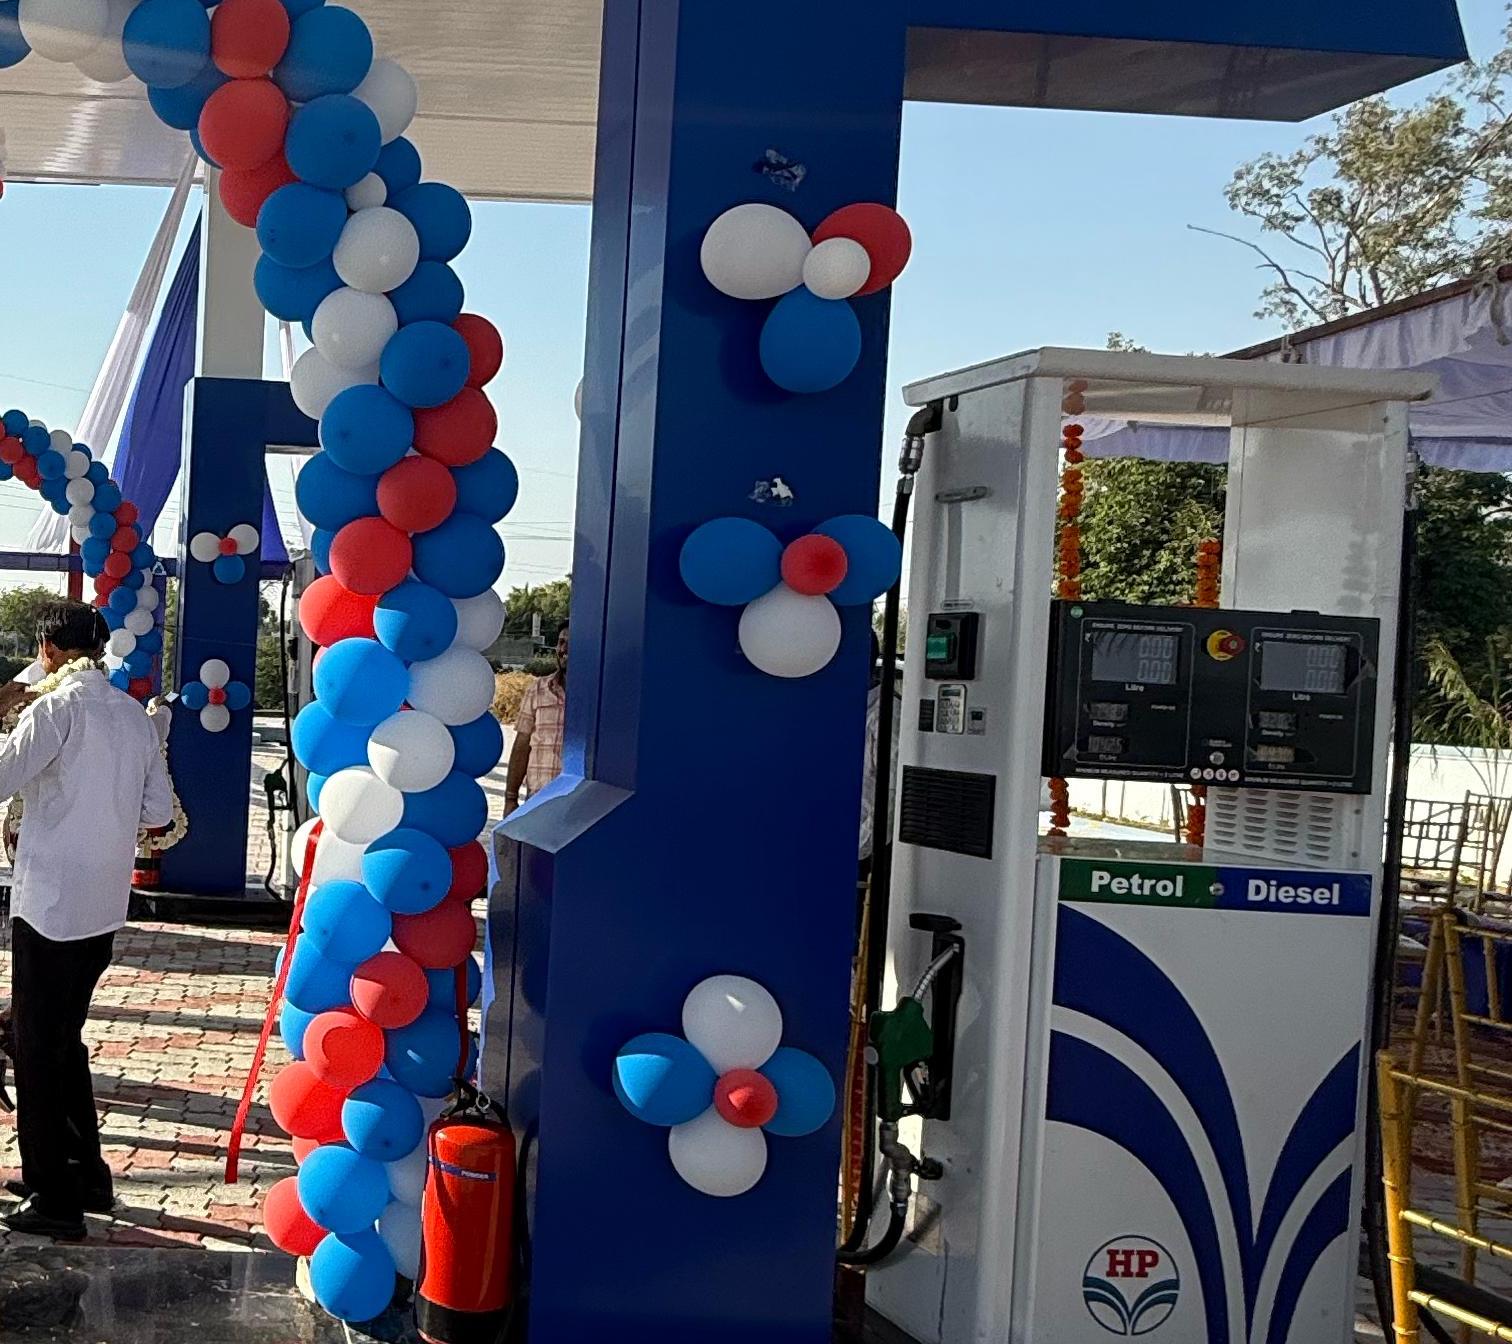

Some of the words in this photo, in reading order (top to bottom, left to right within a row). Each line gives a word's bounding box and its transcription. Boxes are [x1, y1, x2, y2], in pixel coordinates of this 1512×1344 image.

[1090, 870, 1184, 897] Petrol
[1247, 879, 1340, 905] Diesel
[1106, 1249, 1159, 1278] HP
